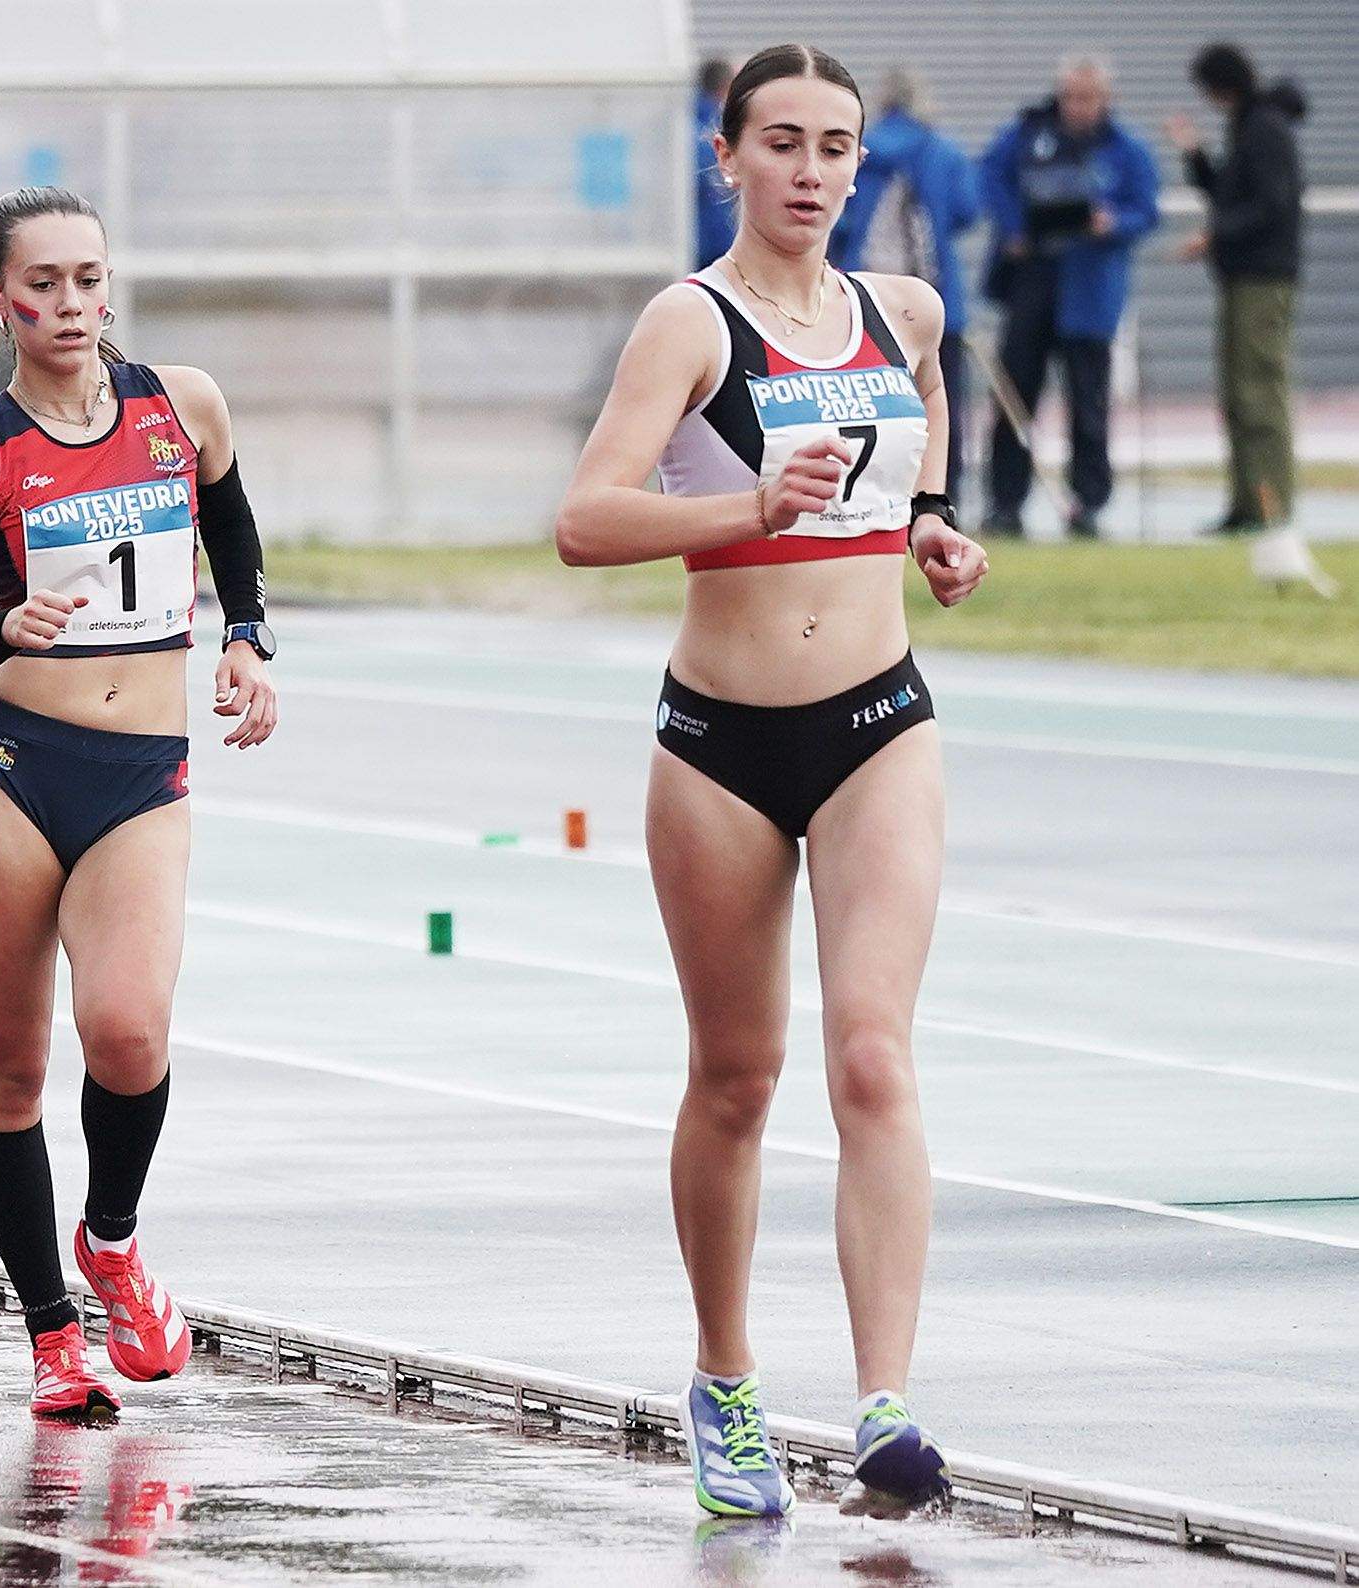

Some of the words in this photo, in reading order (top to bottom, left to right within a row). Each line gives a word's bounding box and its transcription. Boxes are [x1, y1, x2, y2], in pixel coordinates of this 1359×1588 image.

[752, 369, 920, 408] PONTEVEDRA
[816, 397, 879, 422] 2025
[838, 424, 878, 503] 7
[27, 483, 190, 529] PONTEVEDRA
[83, 511, 144, 542] 2025
[108, 540, 137, 612] 1
